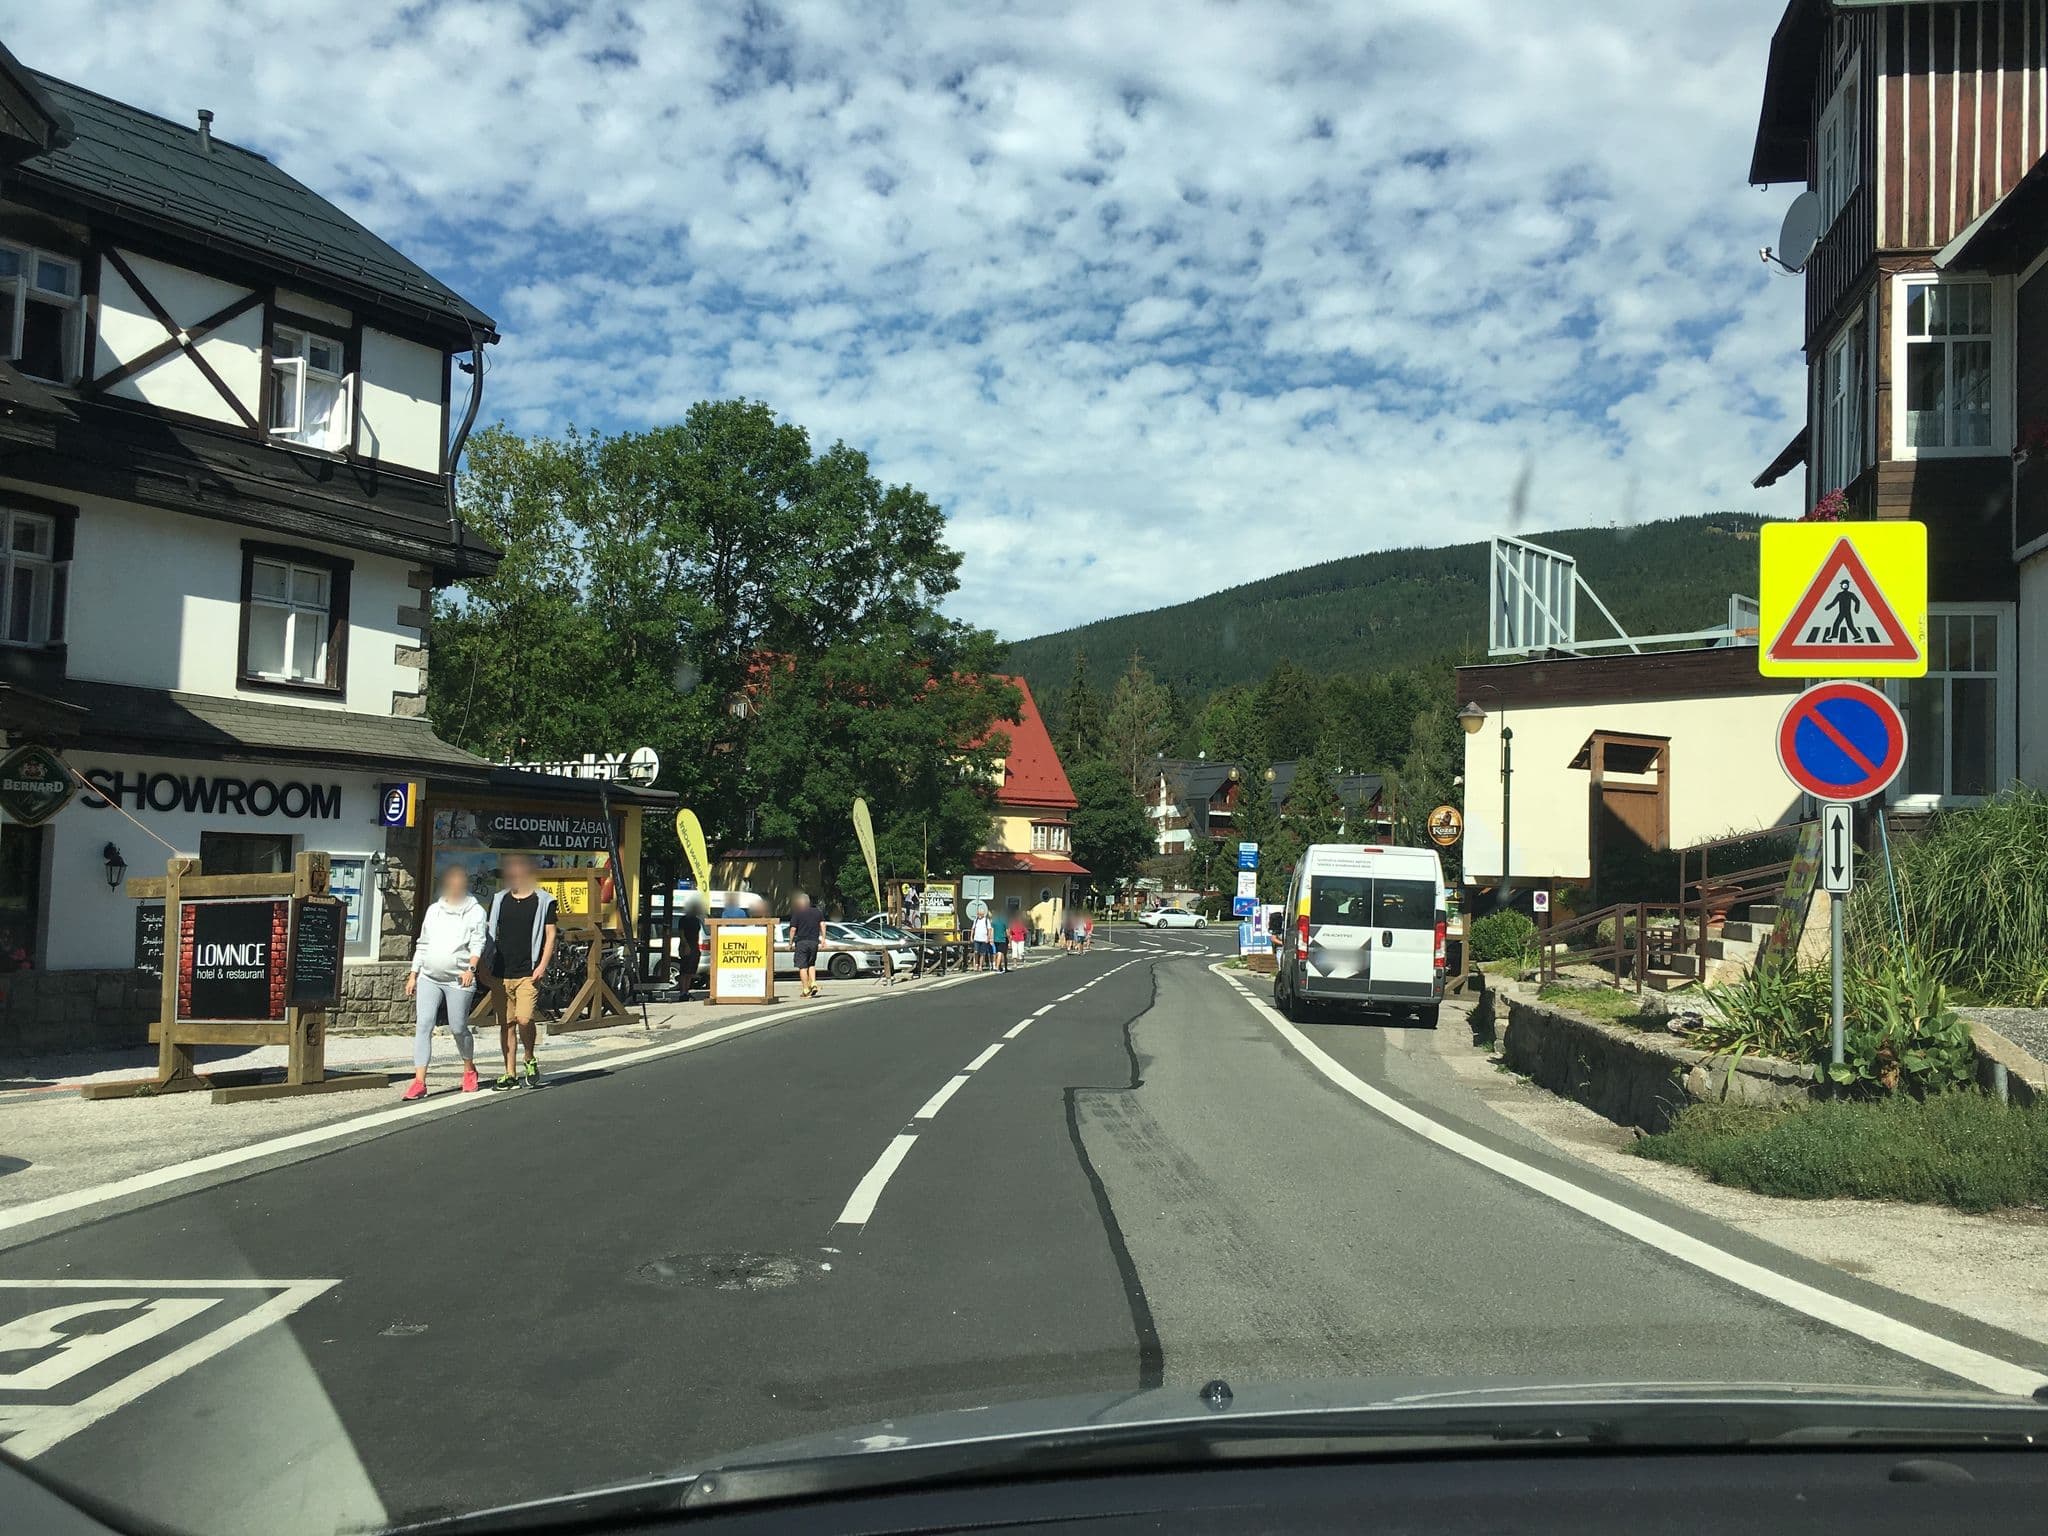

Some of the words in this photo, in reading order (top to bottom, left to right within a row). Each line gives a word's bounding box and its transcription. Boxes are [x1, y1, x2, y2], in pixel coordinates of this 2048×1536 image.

[3, 779, 64, 793] BERNARD
[81, 769, 342, 820] SHOWROOM
[494, 817, 569, 833] CELODENNÍ
[1433, 827, 1457, 835] Kozel
[539, 835, 561, 847] ALL
[565, 836, 590, 848] DAY
[593, 837, 608, 849] FU
[570, 887, 587, 896] RENT
[570, 896, 581, 905] ME
[197, 943, 266, 966] LOMNICE
[722, 956, 762, 964] AKTIVITY
[196, 968, 215, 979] hotel
[217, 968, 223, 979] &
[226, 968, 265, 979] restaurant
